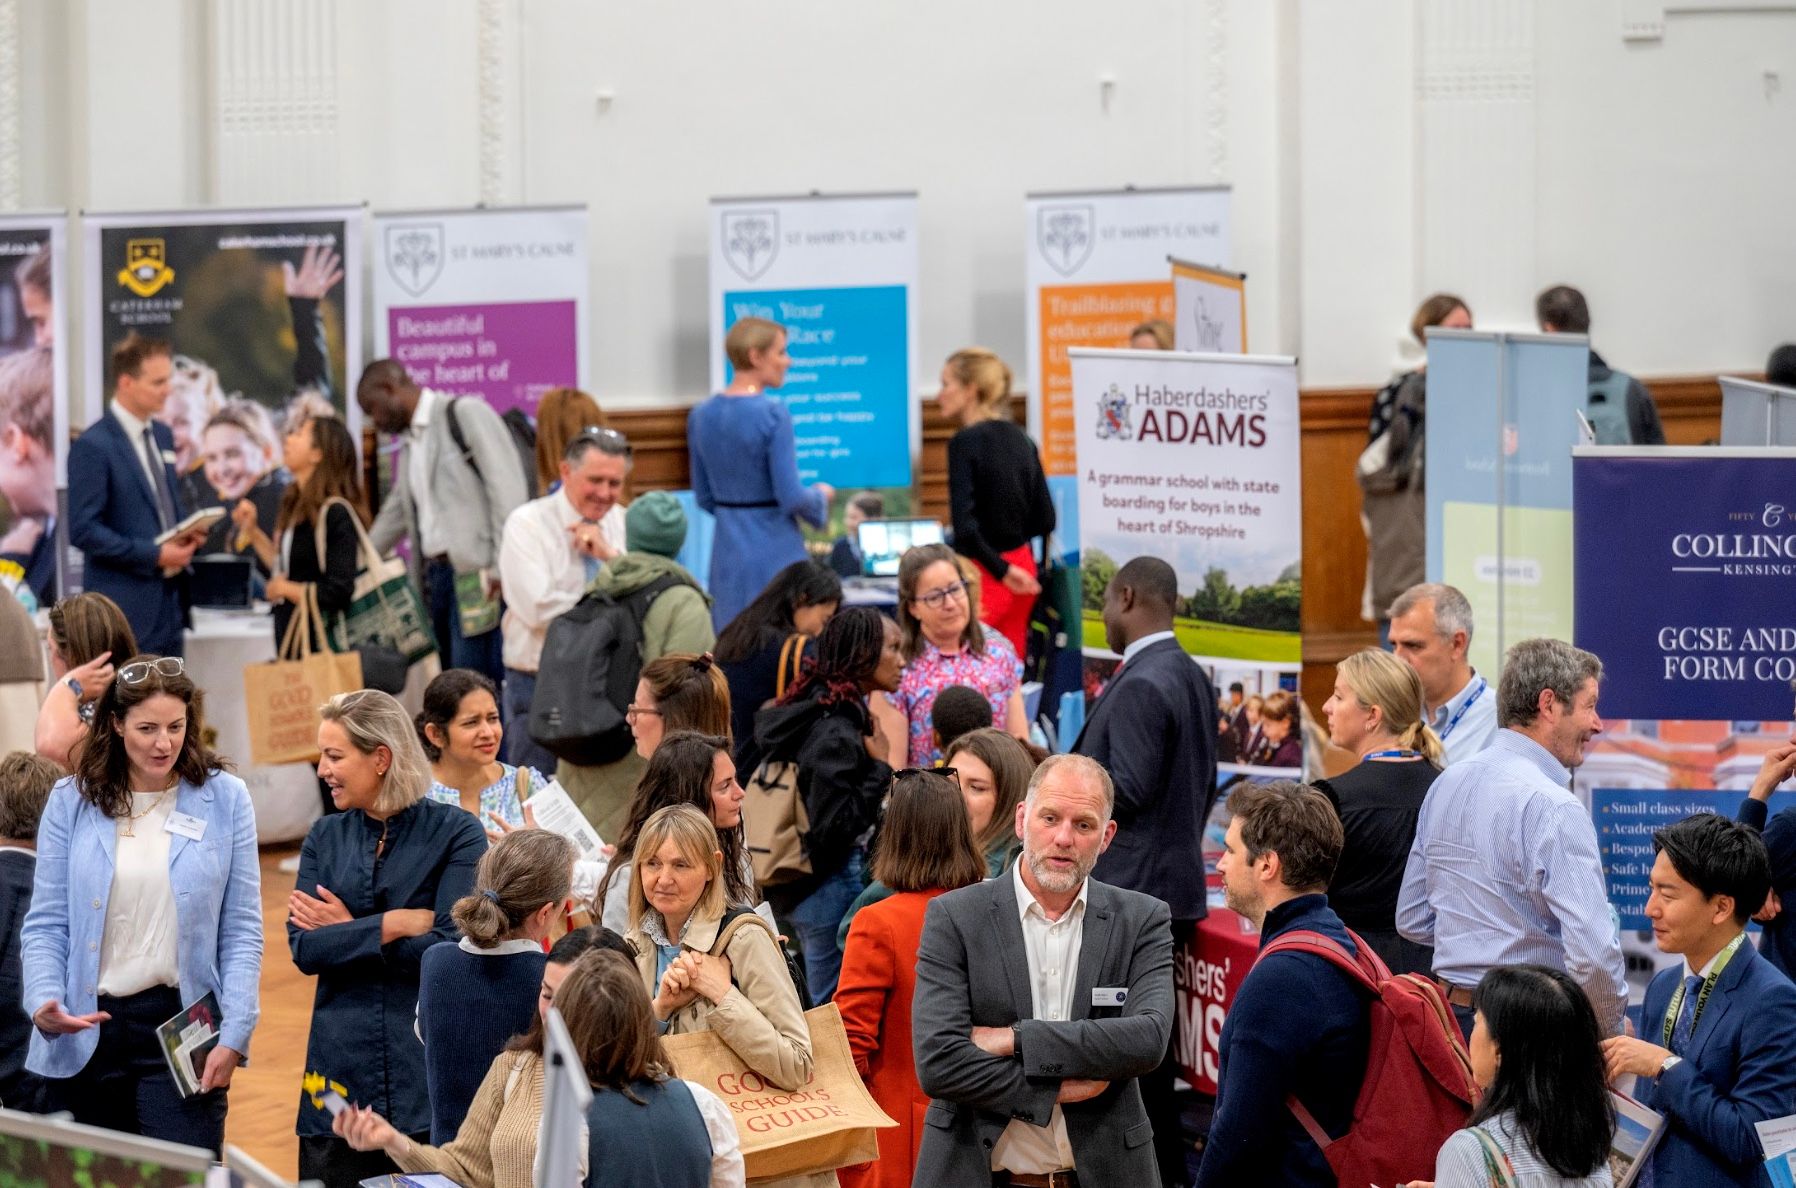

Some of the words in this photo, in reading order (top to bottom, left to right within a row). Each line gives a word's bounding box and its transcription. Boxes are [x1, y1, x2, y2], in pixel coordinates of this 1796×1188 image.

[397, 312, 485, 338] Beautiful
[397, 342, 476, 364] campus
[477, 336, 498, 358] in
[434, 363, 486, 384] heart
[487, 358, 512, 382] of
[1134, 384, 1271, 413] Haberdashers'
[1137, 408, 1267, 448] ADAMS
[1087, 469, 1097, 483] A
[1099, 473, 1163, 489] grammar
[1166, 474, 1210, 490] school
[1211, 478, 1241, 492] with
[1243, 480, 1281, 494] state
[1102, 493, 1166, 515] boarding
[1168, 496, 1187, 512] for
[1190, 499, 1221, 517] boys
[1223, 500, 1235, 514] in
[1238, 502, 1262, 517] the
[1117, 517, 1155, 534] heart
[1158, 519, 1174, 533] of
[1175, 520, 1247, 541] Shropshire
[1657, 626, 1733, 652] GCSE
[1738, 627, 1796, 652] AND
[1663, 656, 1746, 682] FORM
[1611, 802, 1646, 815] Small
[1649, 802, 1681, 815] class
[1684, 803, 1716, 815] sizes
[1611, 863, 1638, 875] Safe
[1611, 883, 1650, 895] Prime
[1701, 971, 1718, 997] PLAN
[1173, 988, 1226, 1084] MS
[717, 1071, 814, 1096] GO
[730, 1088, 831, 1114] SCHOOLS
[746, 1104, 848, 1133] GUIDE
